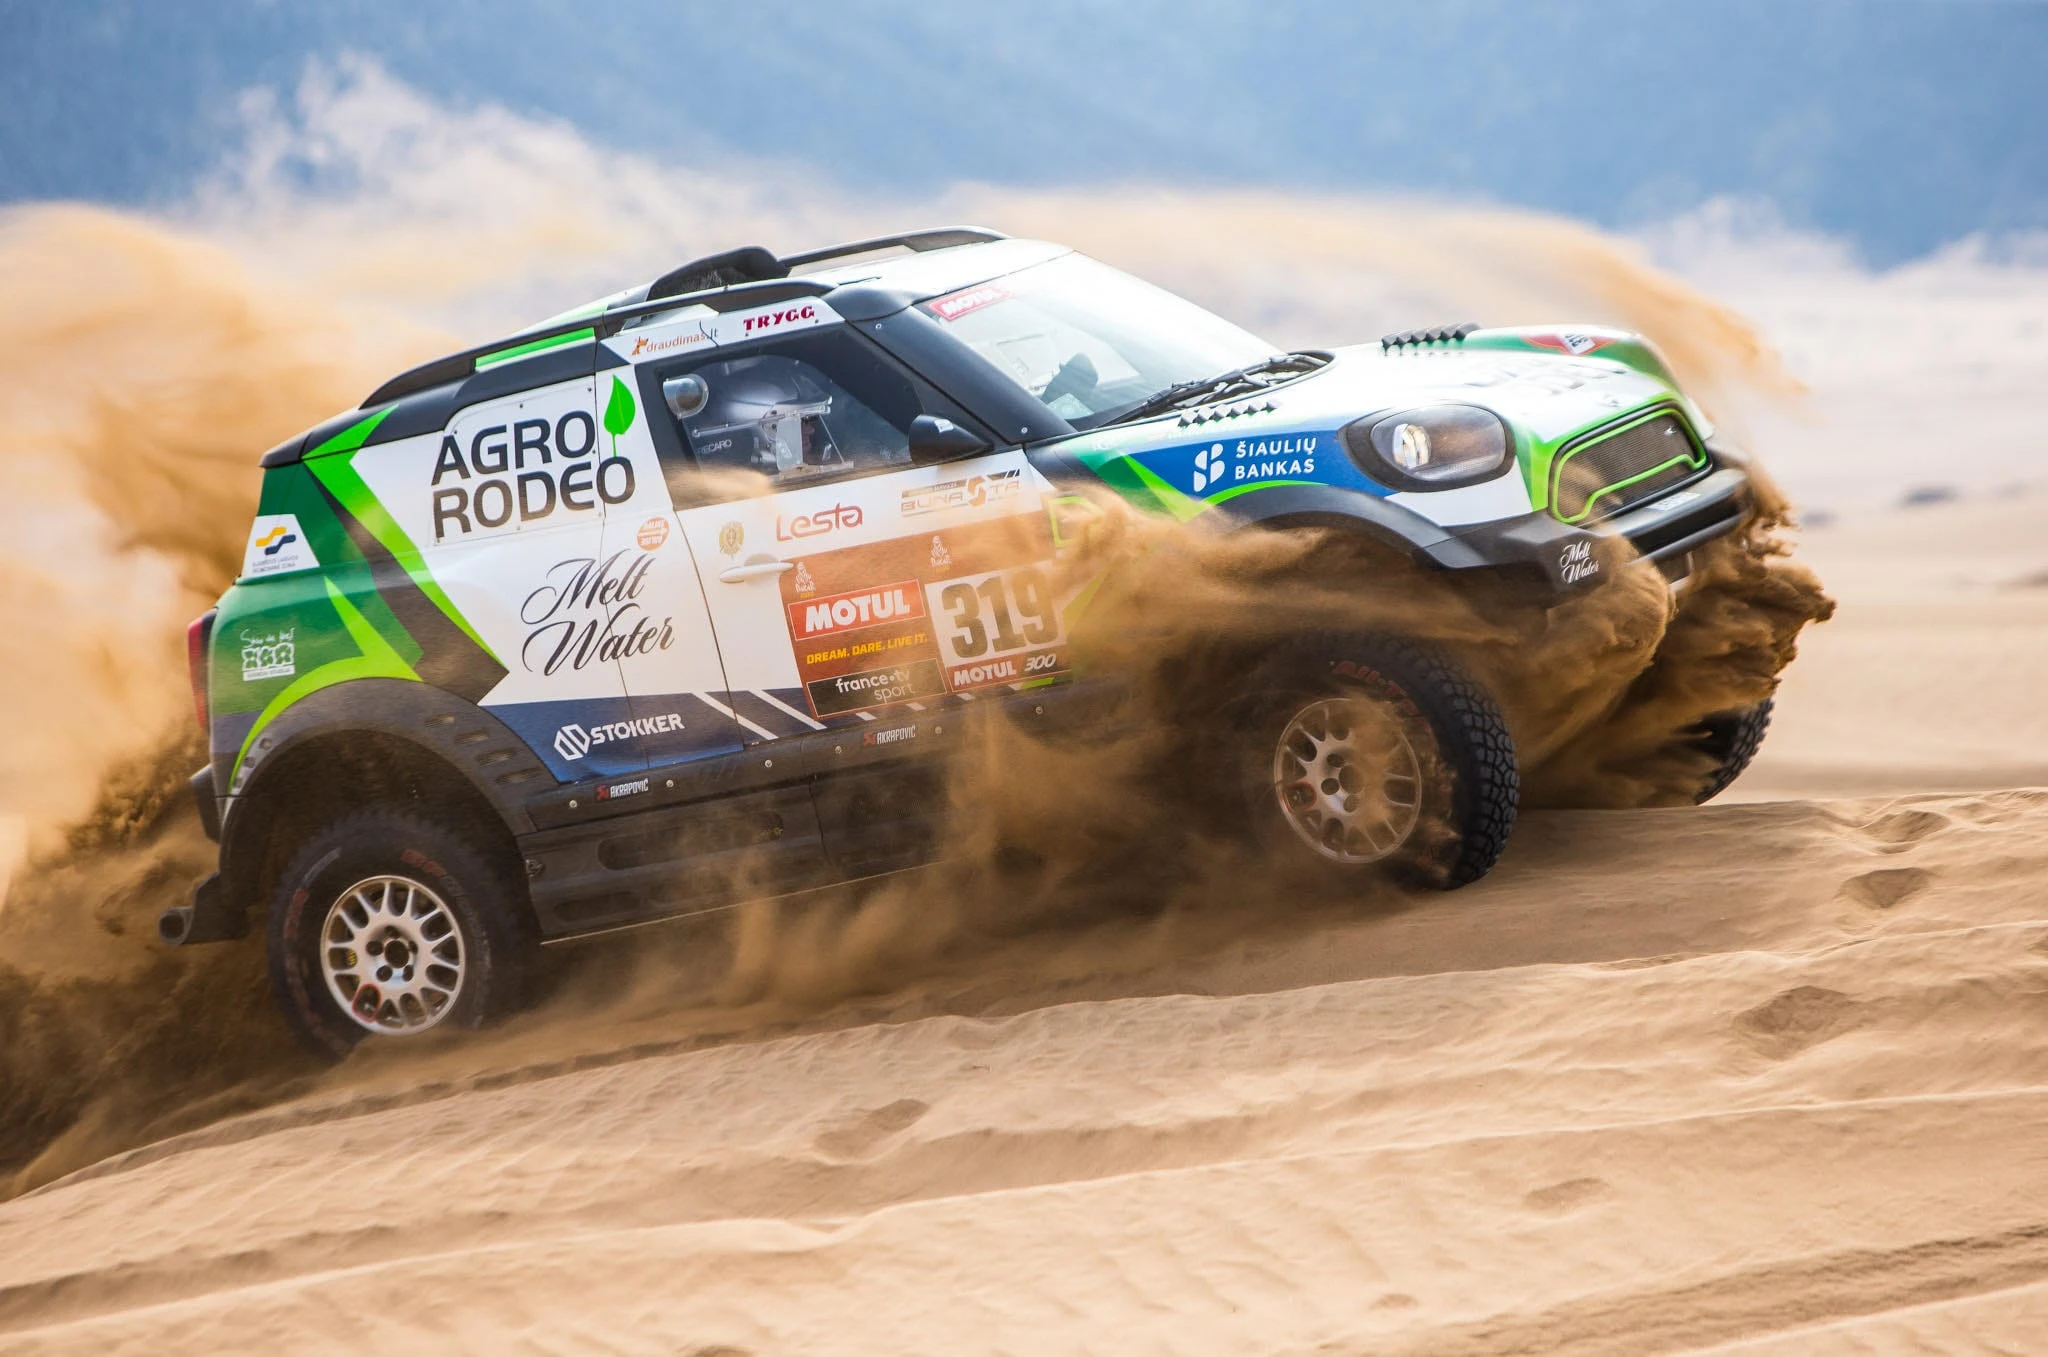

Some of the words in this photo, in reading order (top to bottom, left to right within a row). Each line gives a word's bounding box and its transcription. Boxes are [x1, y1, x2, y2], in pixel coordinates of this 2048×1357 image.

[744, 306, 815, 332] TRYGG
[431, 410, 596, 486] AGRO
[1235, 437, 1317, 459] ŠIAULIŲ
[1234, 458, 1315, 480] BANKAS
[433, 455, 636, 539] RODEO
[776, 502, 863, 542] Lesta
[520, 548, 656, 625] Melt
[805, 588, 910, 634] MOTUL
[941, 570, 1059, 659] 319
[521, 602, 675, 676] Water
[806, 647, 850, 665] DREAM.
[852, 641, 885, 656] DARE.
[887, 636, 912, 649] LIVE
[914, 633, 928, 644] IT.
[953, 660, 1017, 686] MOTUL
[1024, 653, 1057, 671] 300
[874, 683, 915, 705] sport
[590, 713, 685, 745] STOKKER
